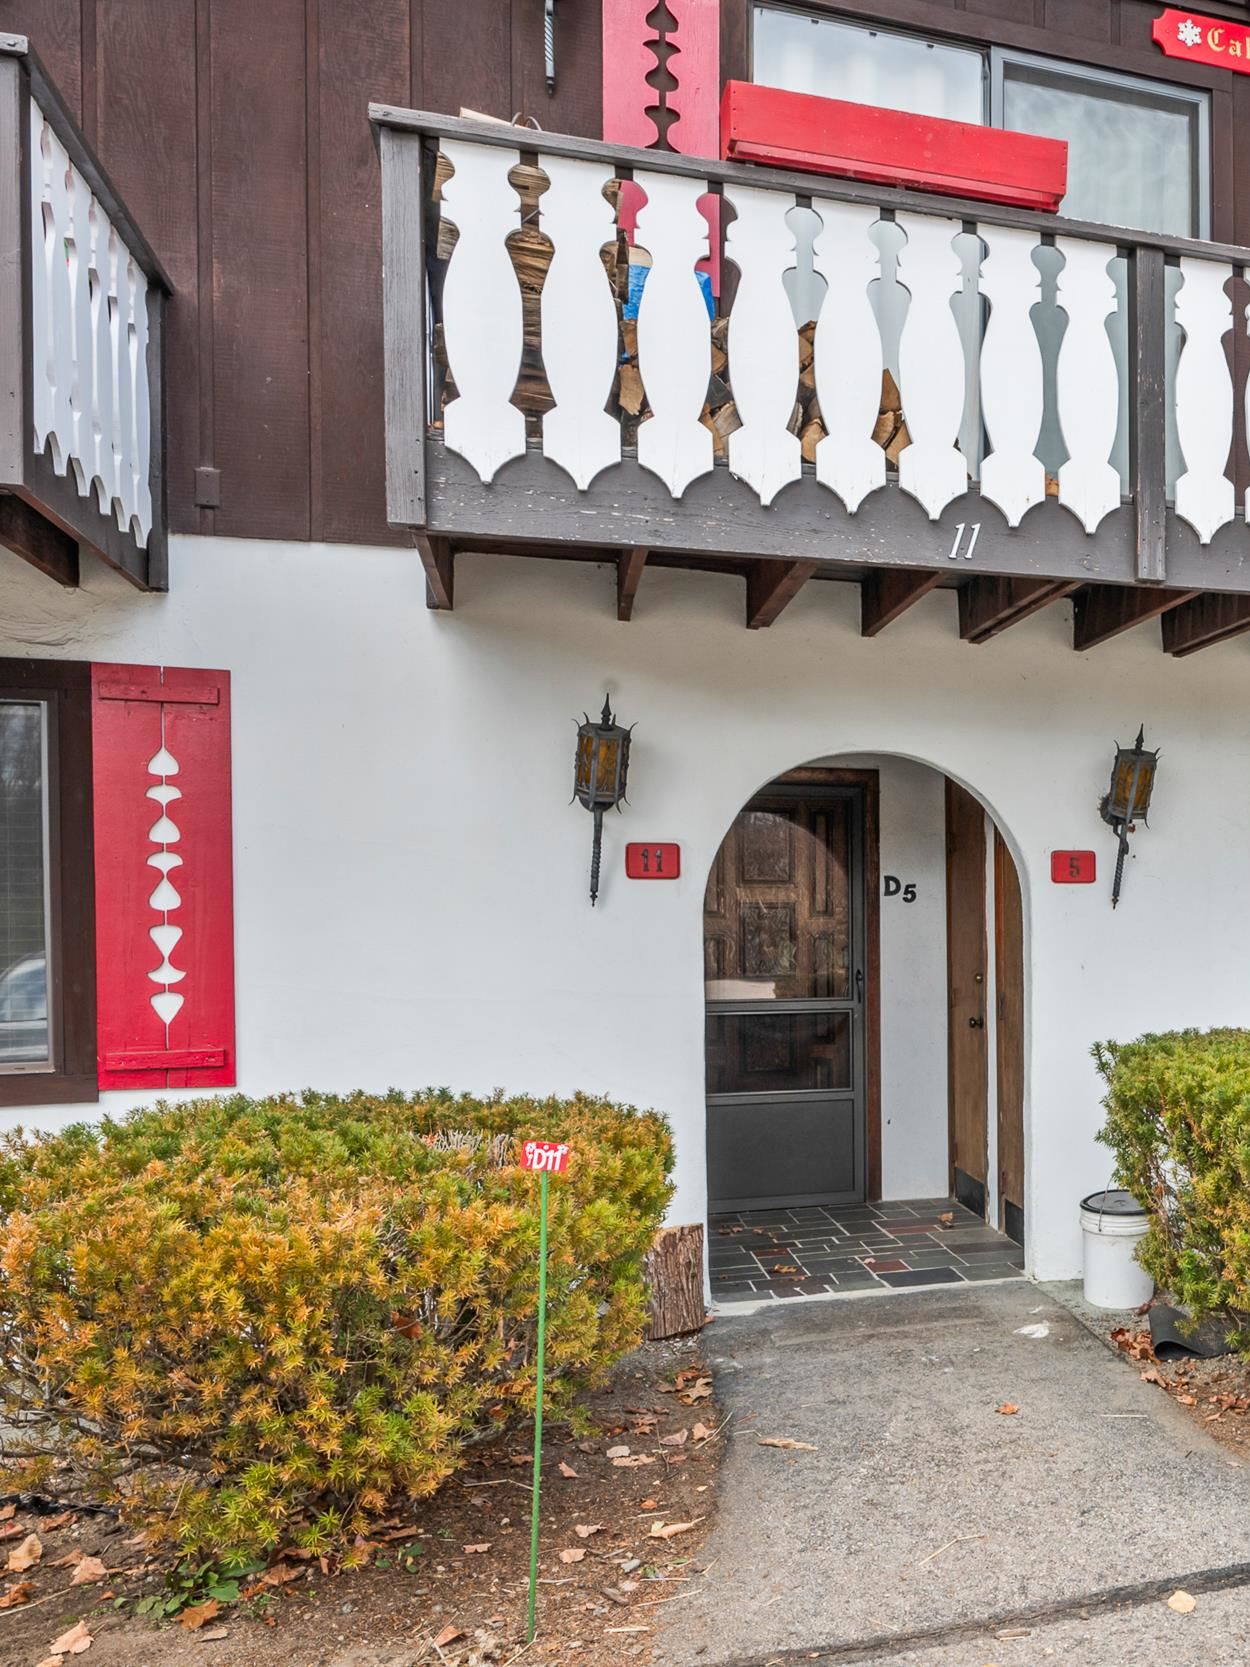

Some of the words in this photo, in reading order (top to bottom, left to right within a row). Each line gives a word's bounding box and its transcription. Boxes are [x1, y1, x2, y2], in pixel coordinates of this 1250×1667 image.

[948, 523, 981, 559] 11
[641, 848, 663, 872] 11
[1069, 857, 1080, 878] 5
[884, 875, 917, 903] D5
[532, 1148, 562, 1170] D11
